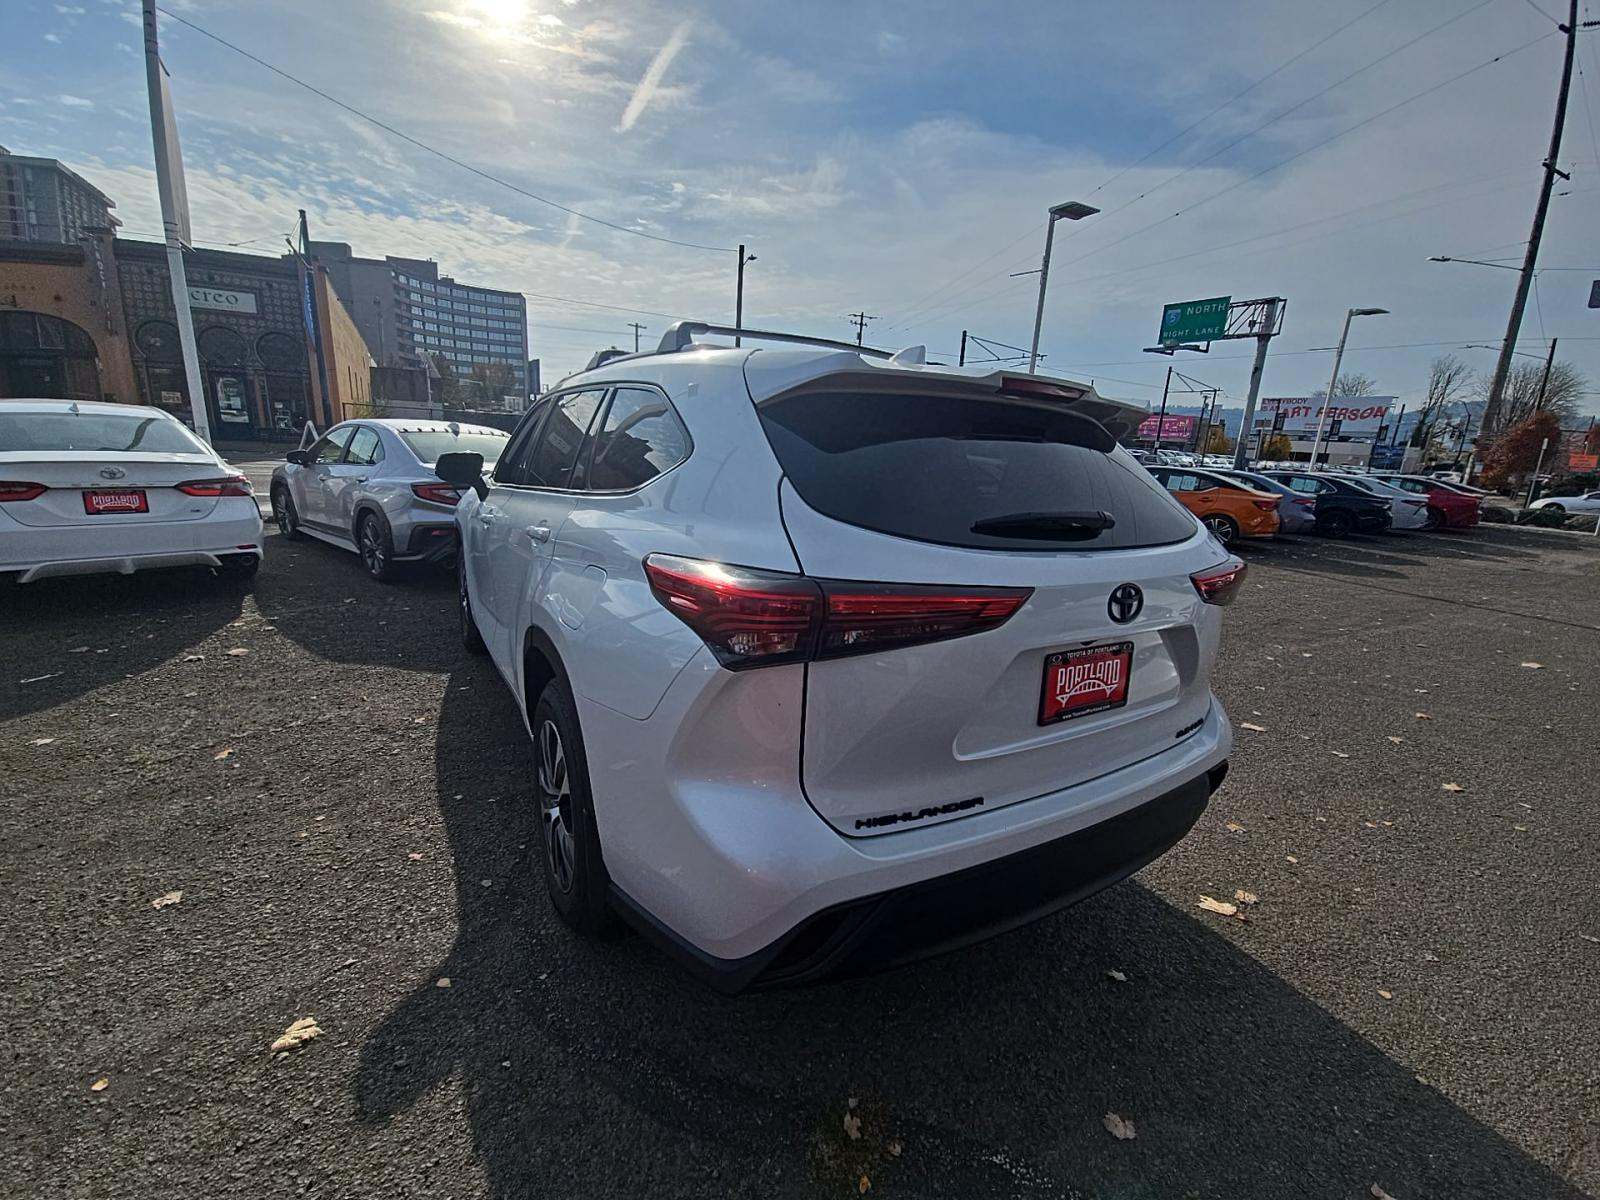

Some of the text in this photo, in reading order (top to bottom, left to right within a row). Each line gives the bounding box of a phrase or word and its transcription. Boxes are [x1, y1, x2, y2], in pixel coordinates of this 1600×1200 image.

[1186, 303, 1226, 316] NORTH
[1162, 326, 1220, 338] RIGHT LANE
[1056, 659, 1121, 695] PORTLAND
[855, 796, 984, 830] HIGHLANDER
